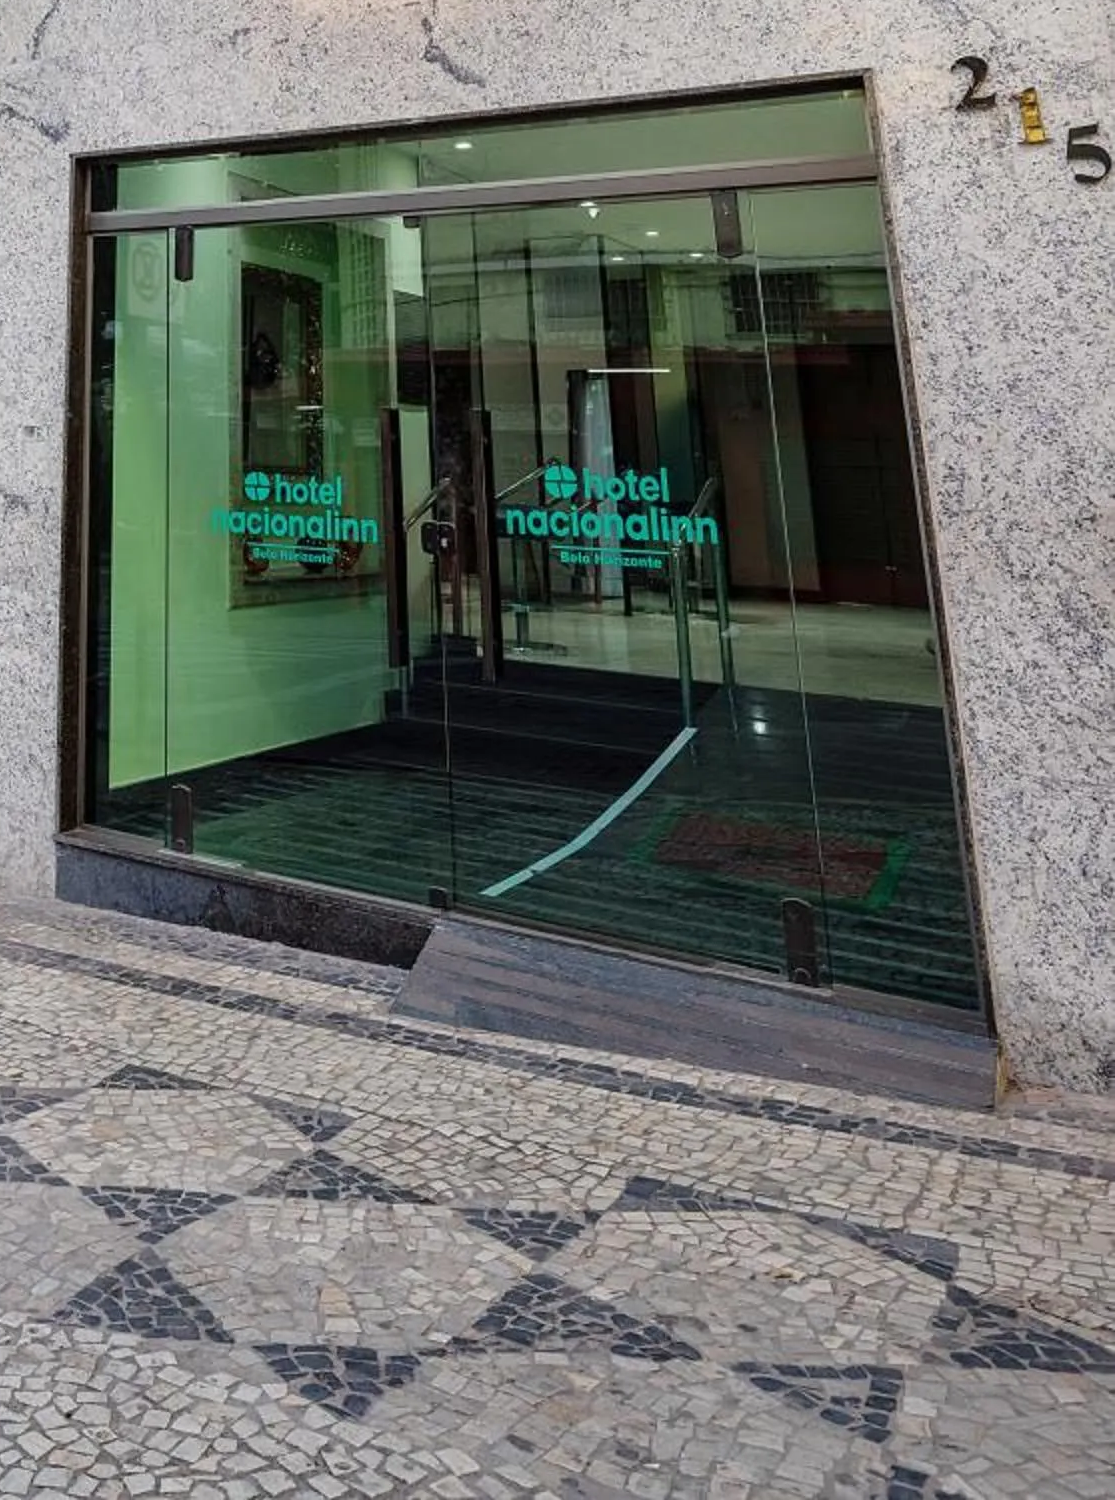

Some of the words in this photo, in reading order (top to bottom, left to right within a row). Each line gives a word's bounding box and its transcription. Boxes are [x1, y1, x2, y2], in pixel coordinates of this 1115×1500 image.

[950, 55, 1112, 184] 215
[274, 473, 343, 506] hotel
[582, 467, 670, 503] hotel
